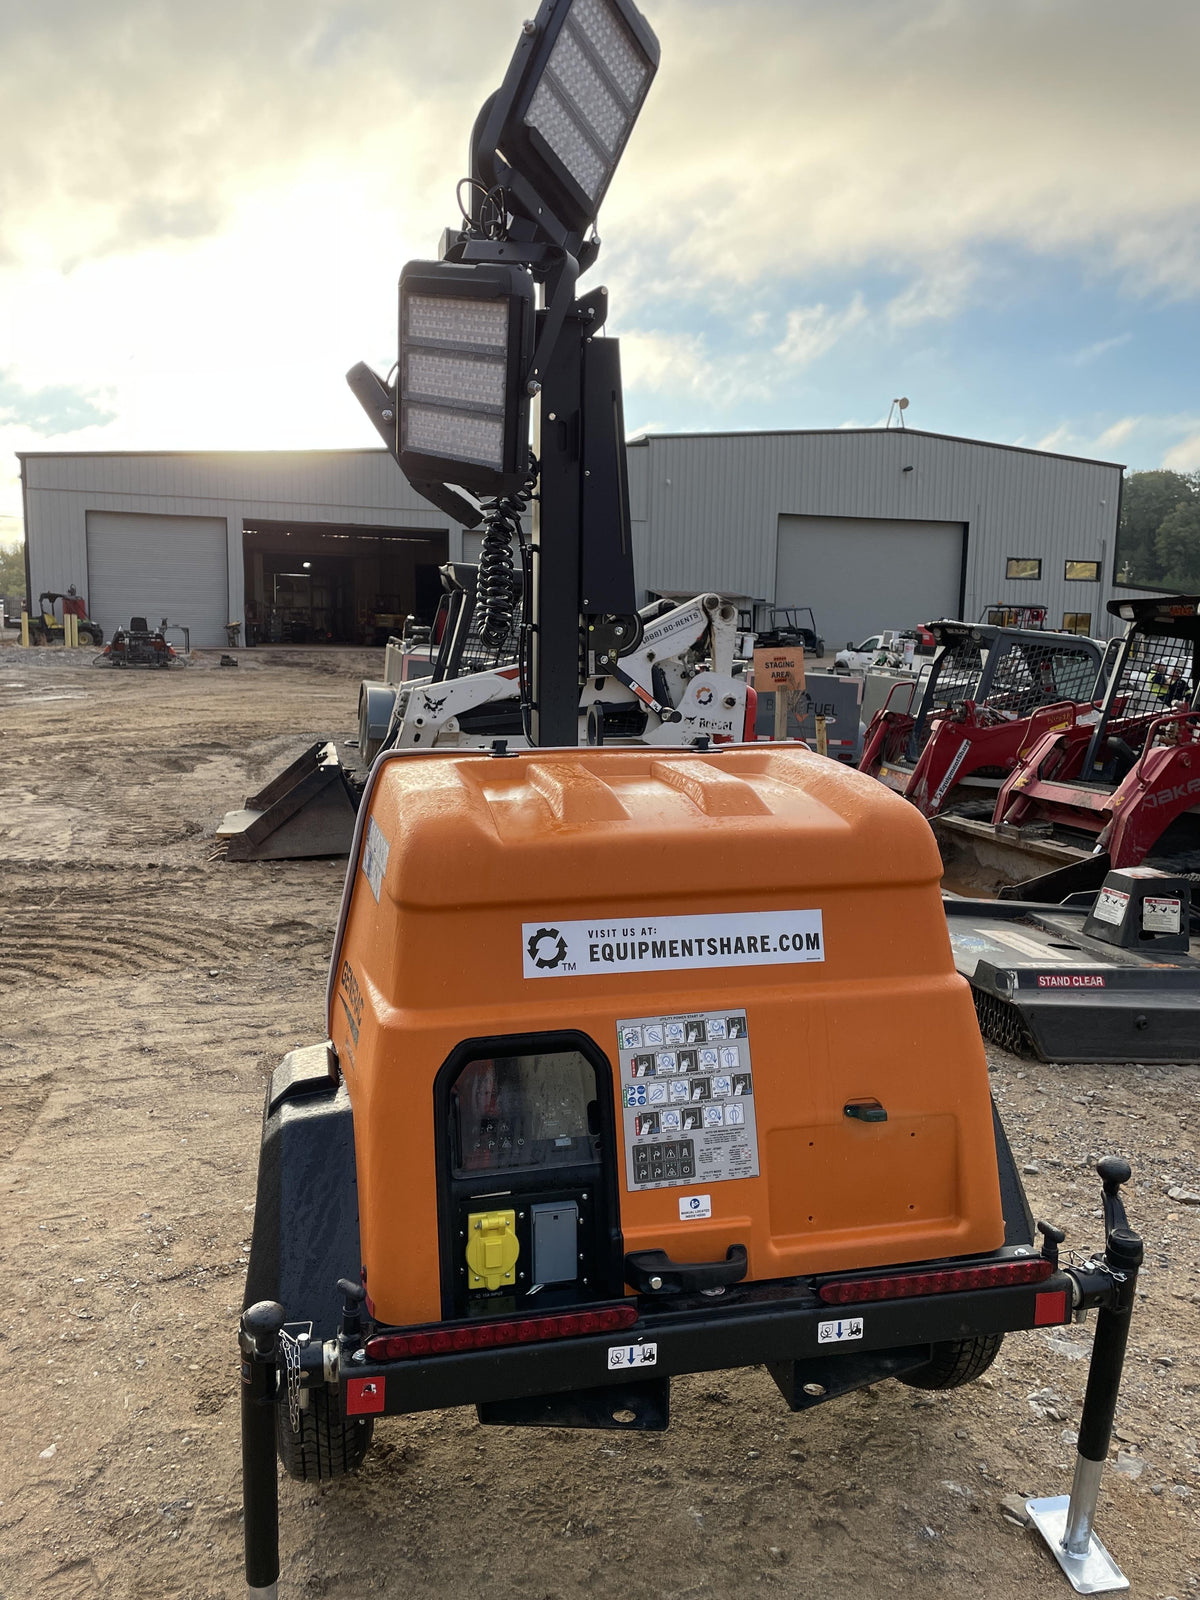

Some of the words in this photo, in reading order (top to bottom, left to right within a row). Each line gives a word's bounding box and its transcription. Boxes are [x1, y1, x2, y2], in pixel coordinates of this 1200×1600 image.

[765, 660, 795, 669] STAGING
[771, 671, 790, 679] AREA
[806, 702, 838, 716] FUEL
[588, 928, 617, 939] VISIT
[622, 928, 636, 937] US
[641, 926, 658, 936] AT:
[589, 932, 820, 963] EQUIPMENTSHARE.COM
[562, 962, 577, 971] TM
[1039, 976, 1070, 986] STAND
[1072, 976, 1104, 986] CLEAR
